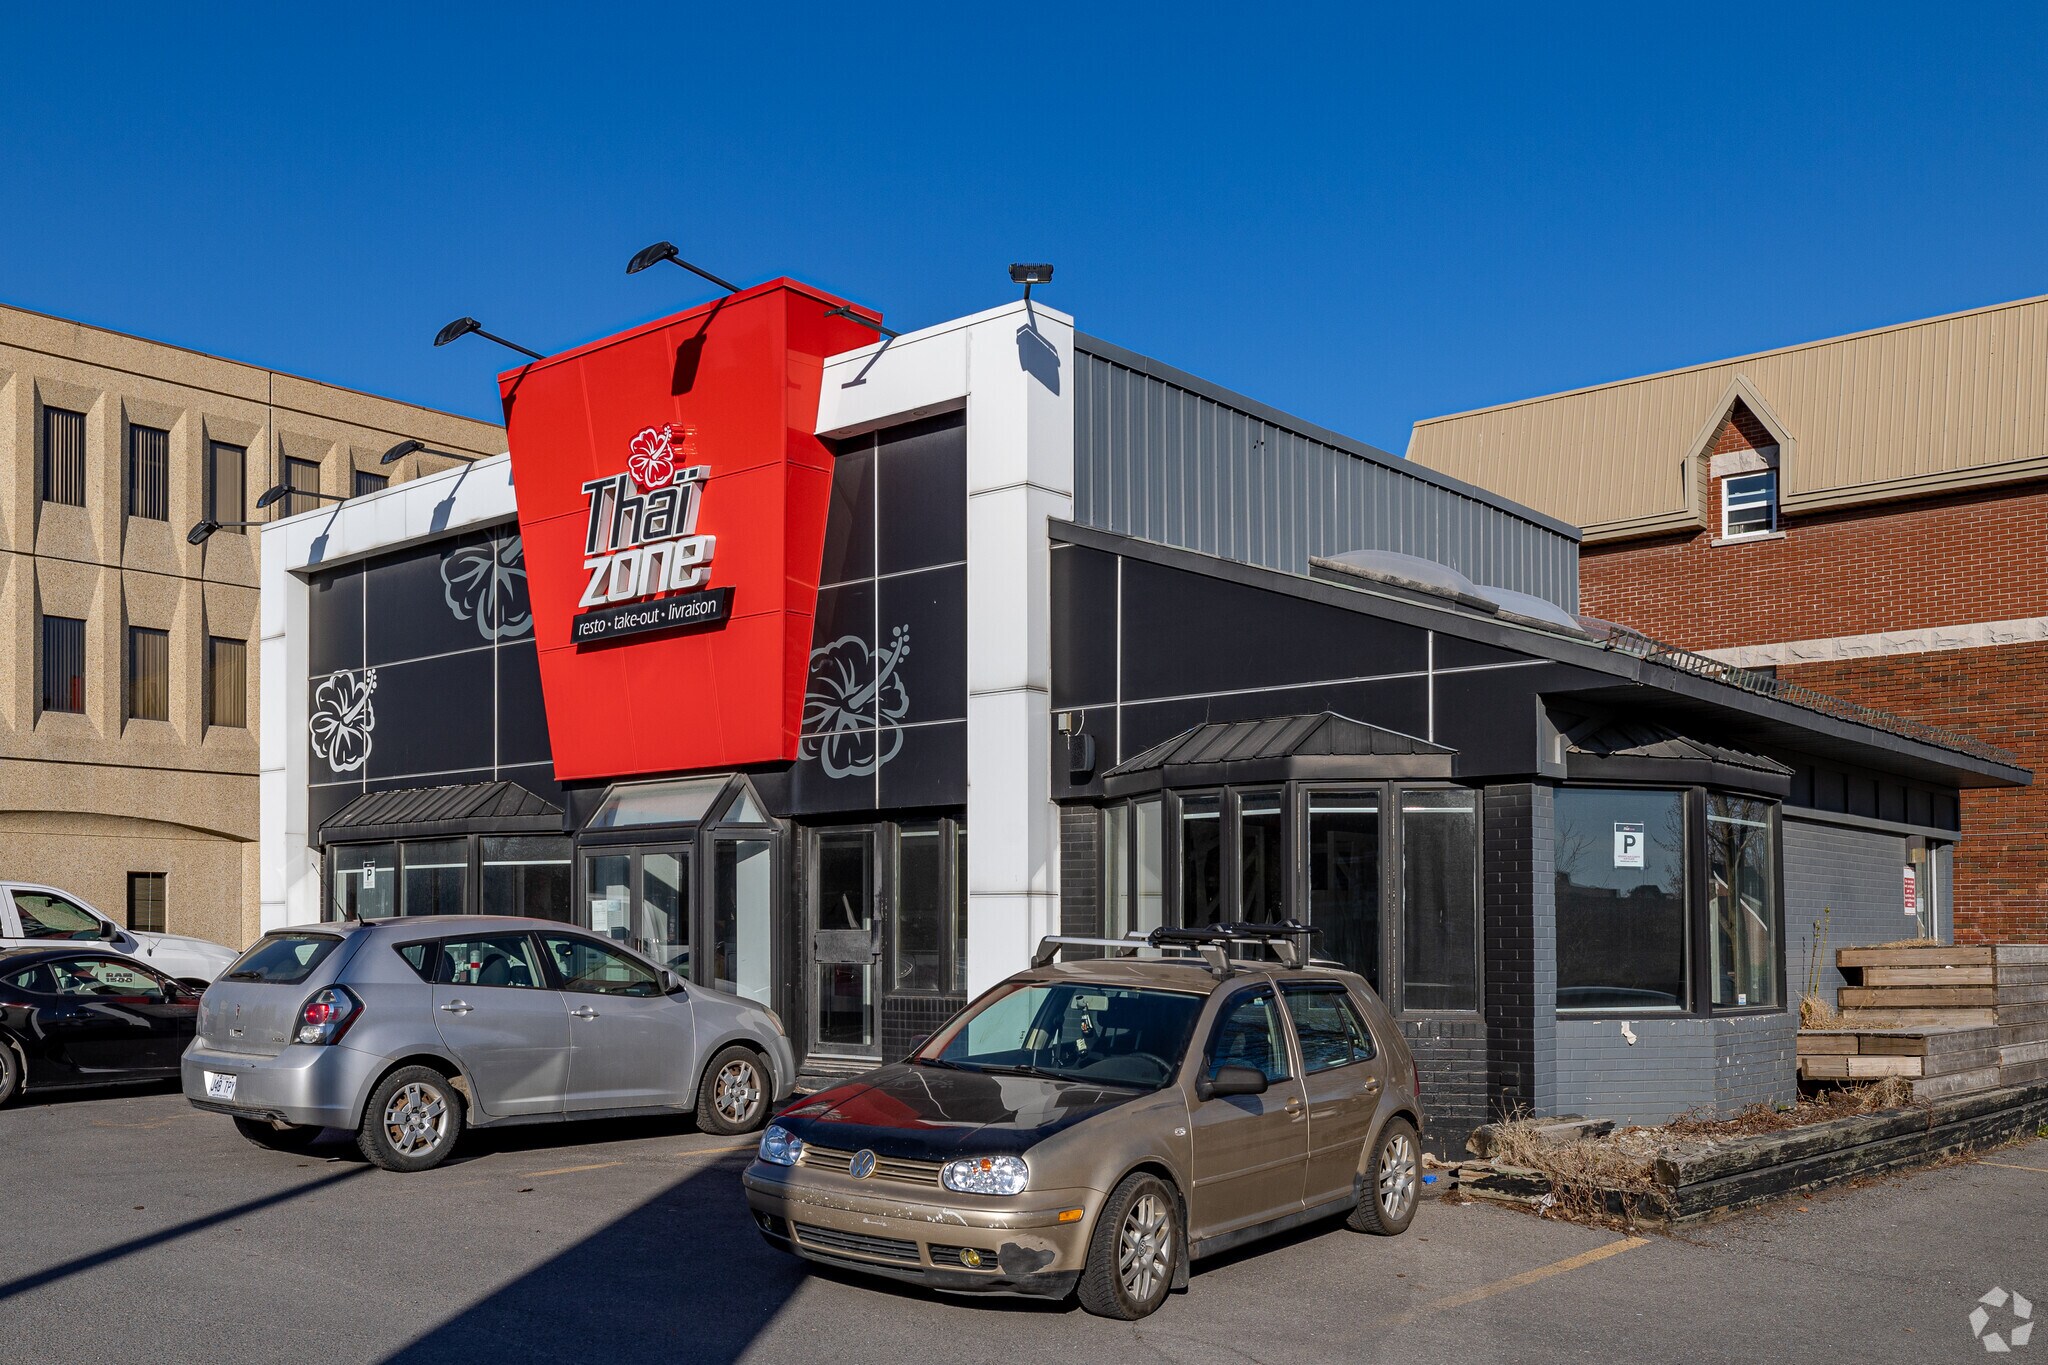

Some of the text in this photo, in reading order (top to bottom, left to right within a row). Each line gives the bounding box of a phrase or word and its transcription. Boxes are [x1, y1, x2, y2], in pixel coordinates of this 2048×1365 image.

[581, 465, 704, 556] Thaï
[578, 599, 717, 636] resto take-out livraison
[1623, 835, 1636, 854] P
[367, 869, 373, 881] P
